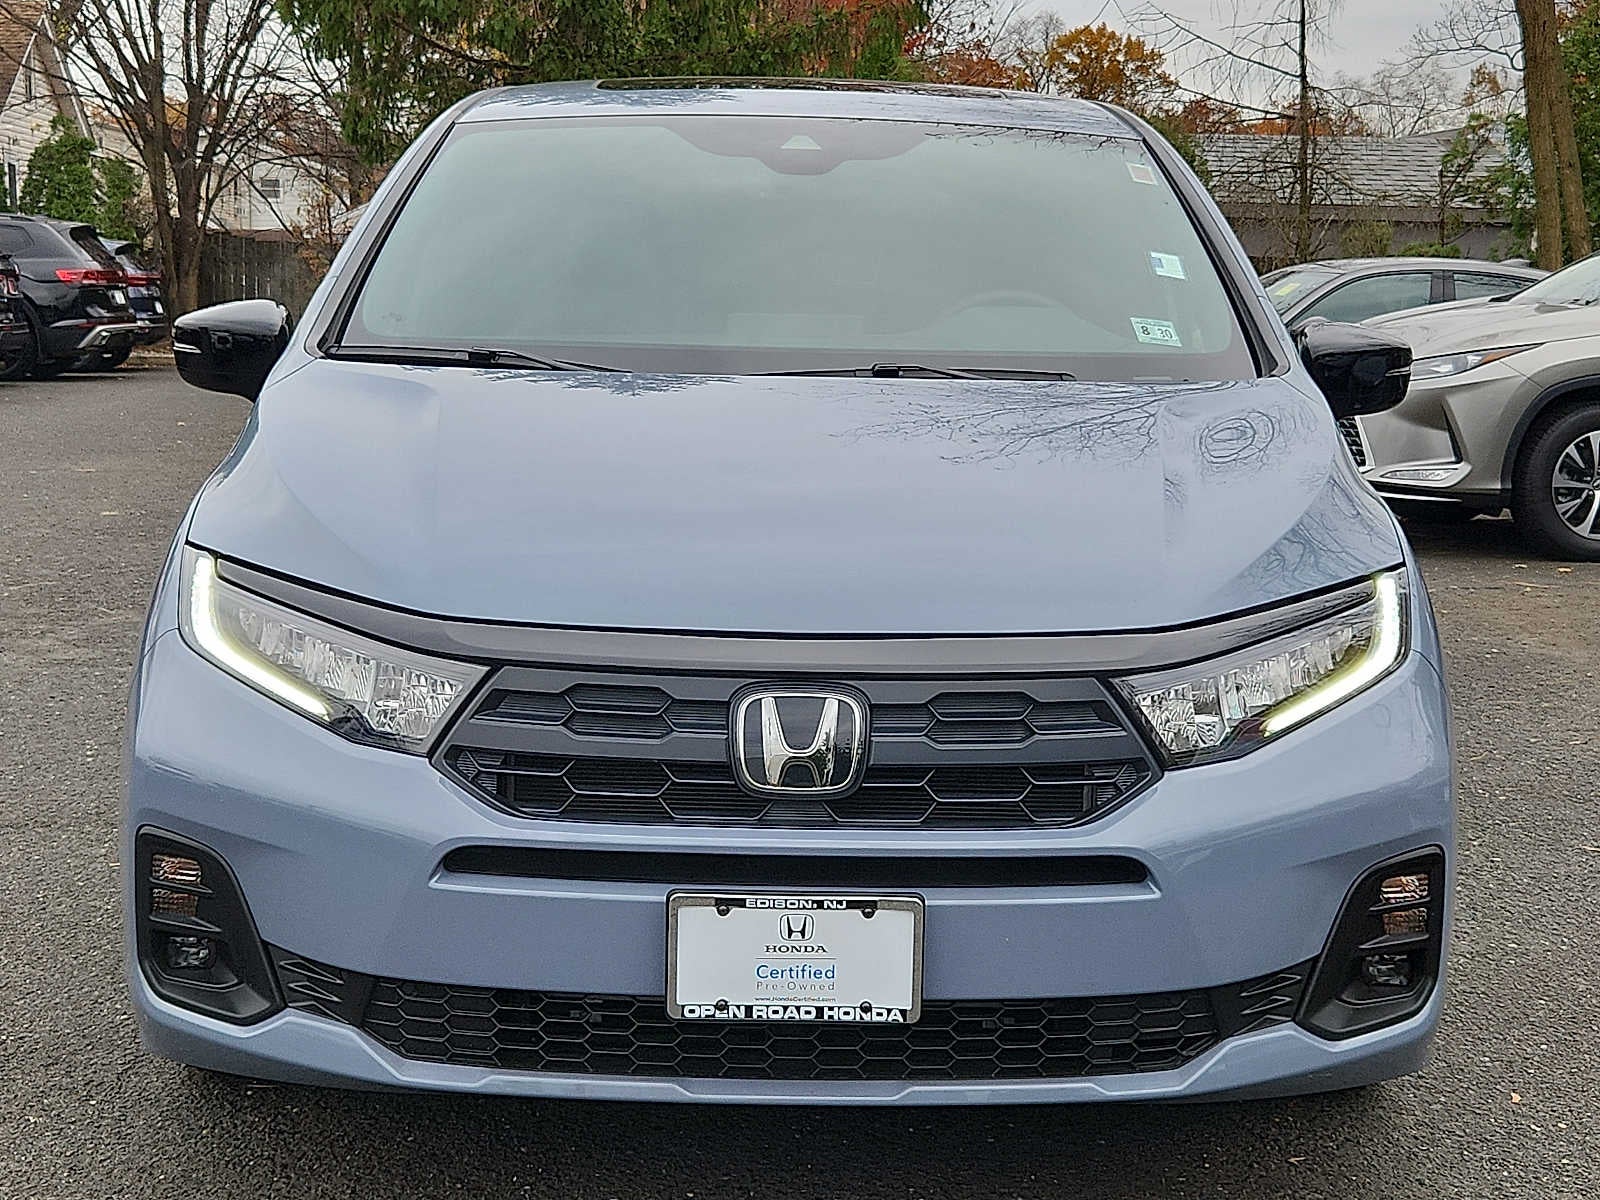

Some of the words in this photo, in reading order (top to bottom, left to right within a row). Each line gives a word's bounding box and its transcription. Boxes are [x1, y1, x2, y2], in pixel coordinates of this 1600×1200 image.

[1141, 326, 1151, 335] 8
[823, 899, 848, 910] NJ
[764, 944, 829, 954] HONDA
[756, 964, 836, 979] Certified
[756, 981, 835, 991] Pre-Owned
[752, 1005, 817, 1020] ROAD
[824, 1006, 904, 1022] HONDA
